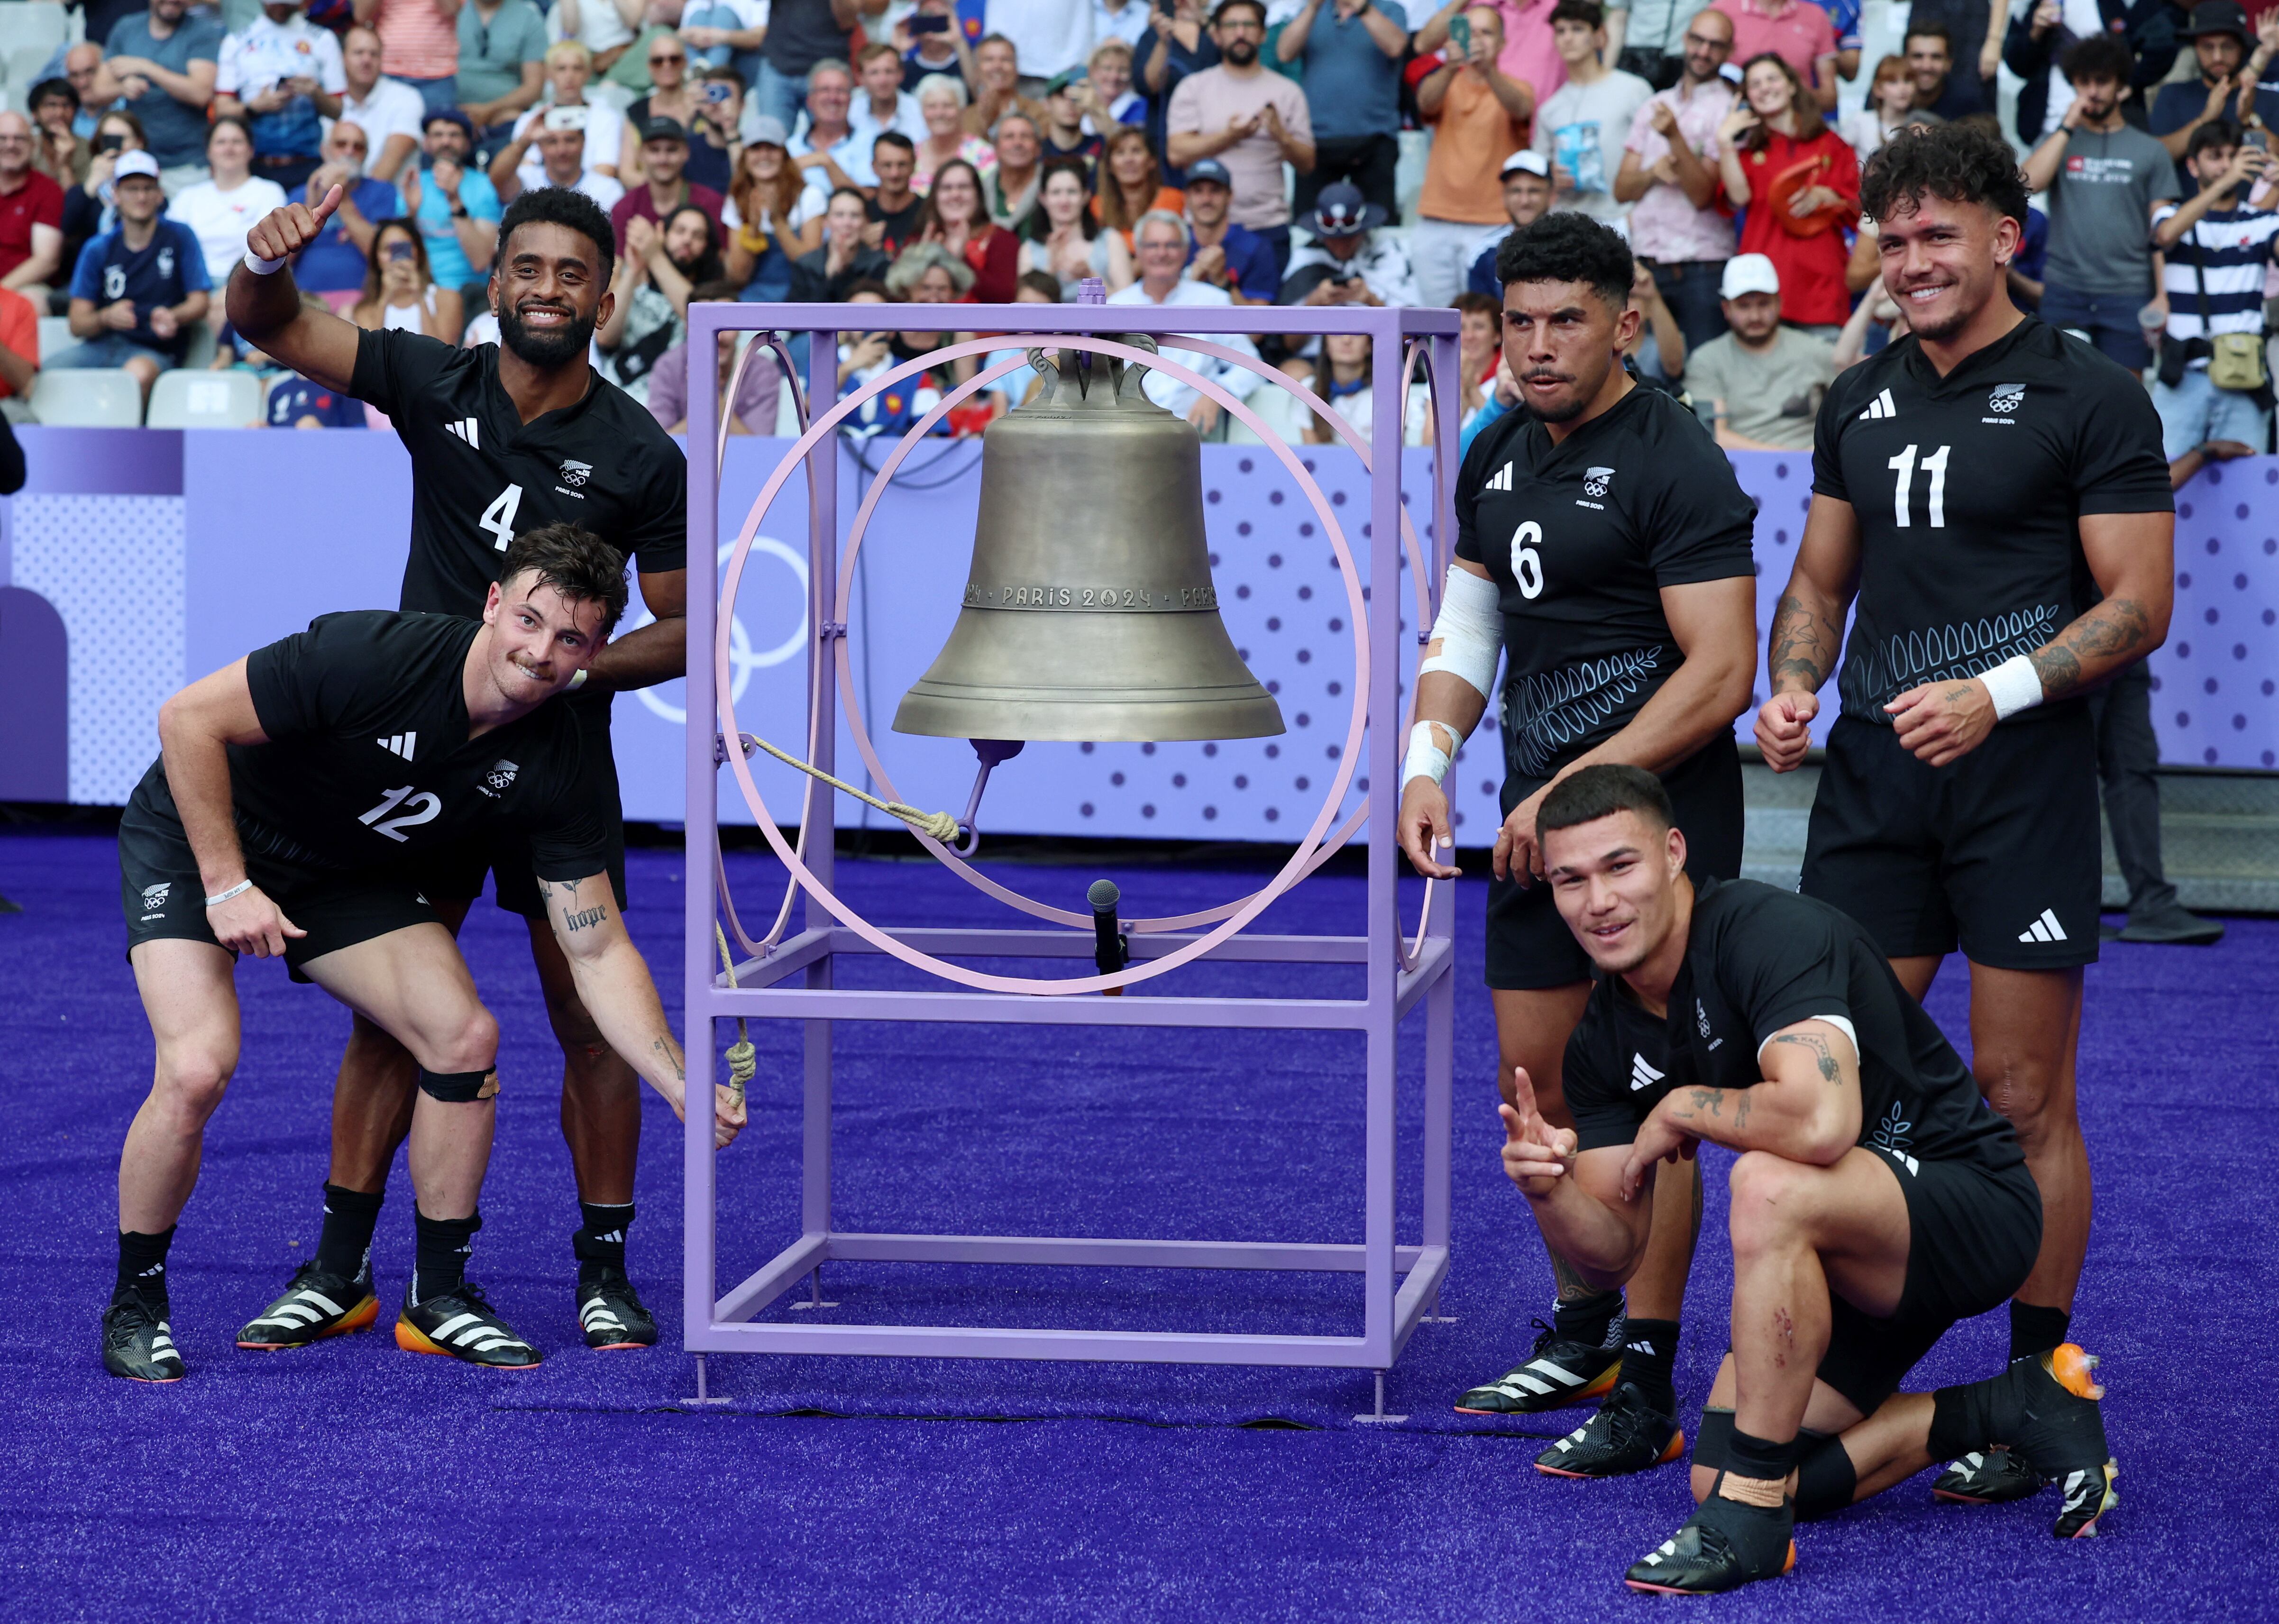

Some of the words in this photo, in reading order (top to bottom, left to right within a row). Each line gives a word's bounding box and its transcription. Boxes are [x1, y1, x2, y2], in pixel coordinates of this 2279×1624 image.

[570, 491, 584, 499] 2024
[1887, 444, 1951, 528] 11
[478, 483, 523, 553] 4
[1590, 502, 1604, 511] 2024
[1511, 520, 1544, 600] 6
[1082, 588, 1151, 608] 2024
[503, 771, 515, 781] TEAM
[358, 785, 441, 842] 12
[223, 891, 234, 899] HOPE
[563, 904, 607, 932] hope
